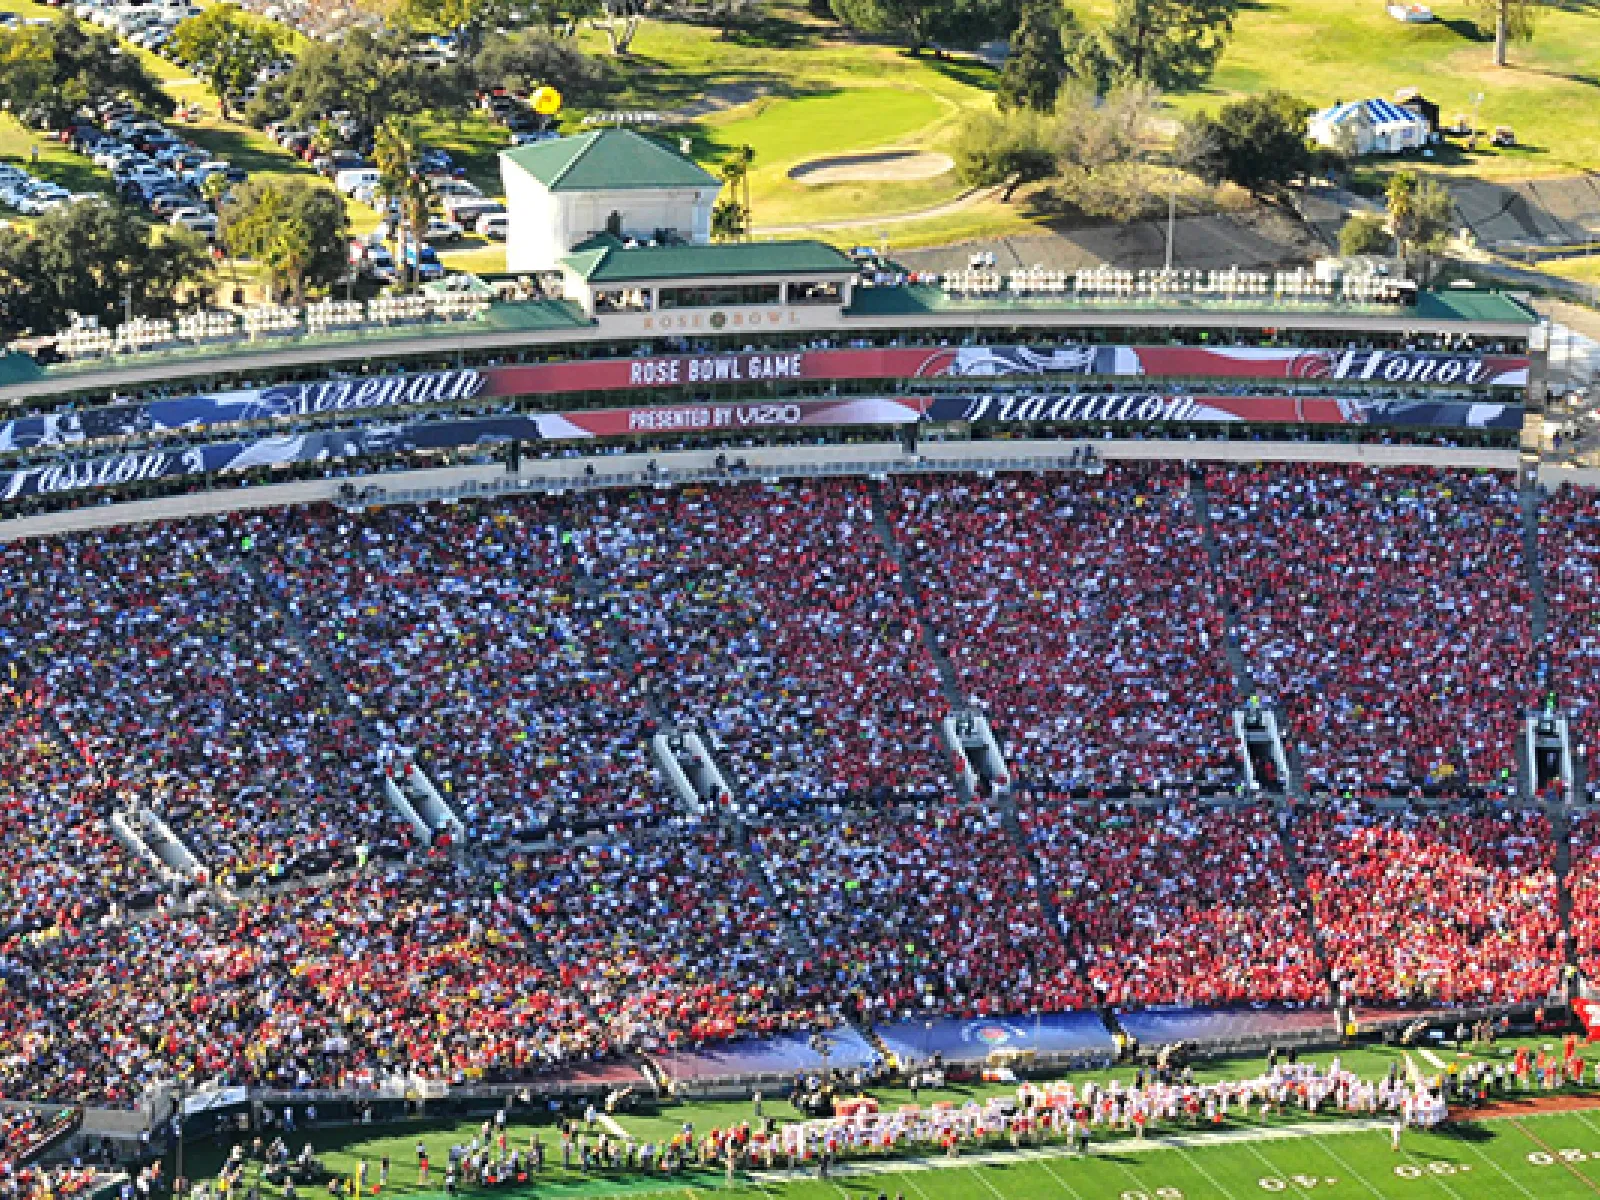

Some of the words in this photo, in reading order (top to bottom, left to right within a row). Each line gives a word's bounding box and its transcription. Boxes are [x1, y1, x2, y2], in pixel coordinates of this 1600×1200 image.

[630, 359, 681, 384] ROSE
[688, 358, 741, 382] BOWL
[748, 354, 801, 379] GAME
[1333, 350, 1487, 384] Honor
[629, 407, 710, 430] PRESENTED
[714, 407, 733, 427] BY
